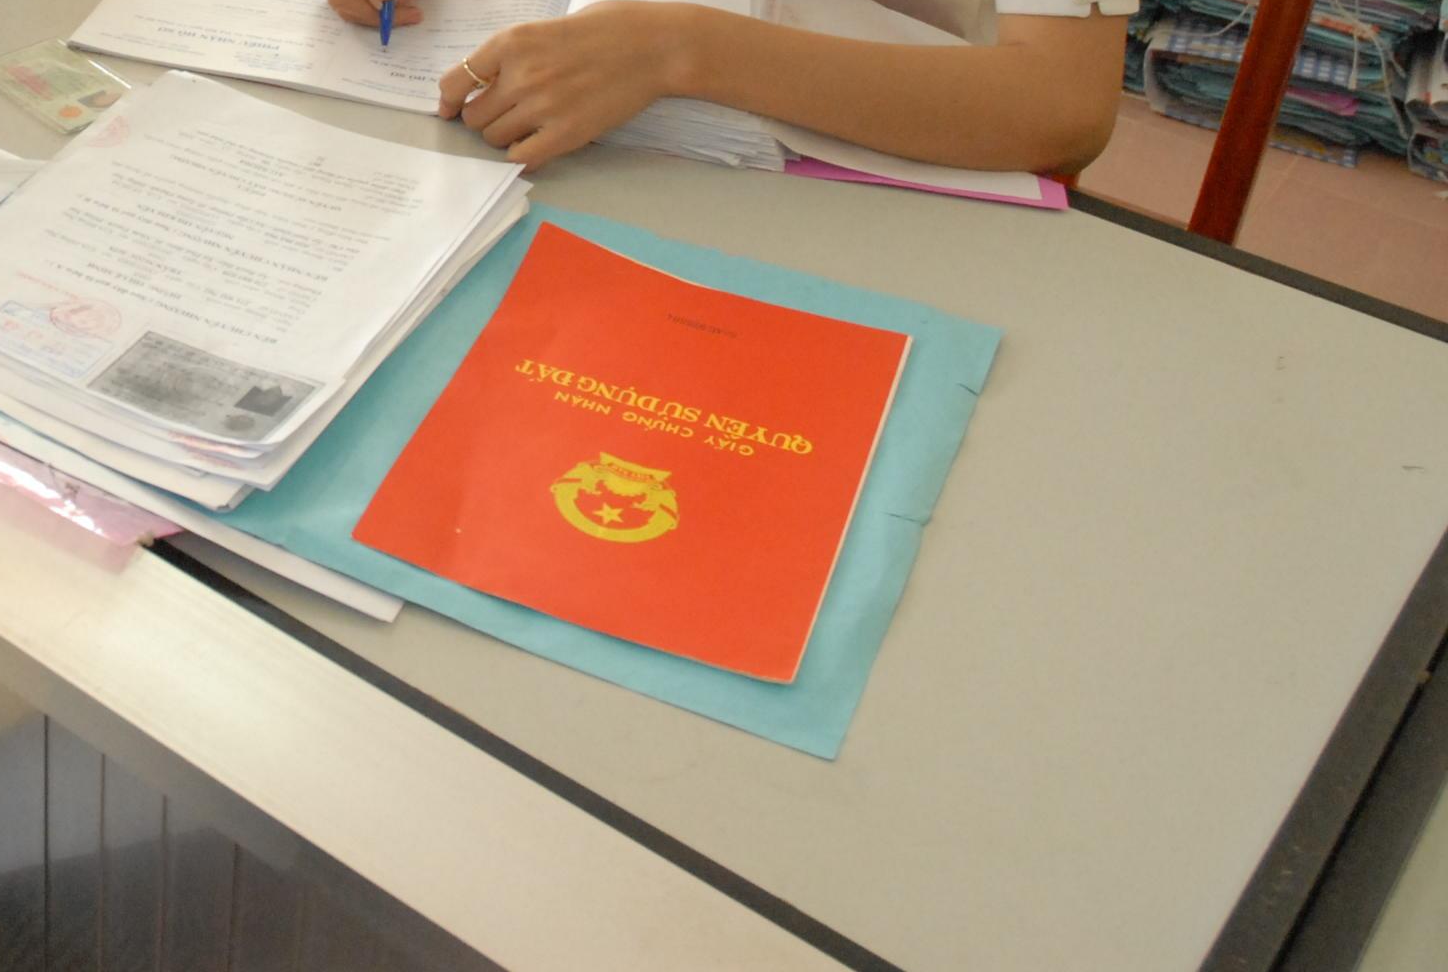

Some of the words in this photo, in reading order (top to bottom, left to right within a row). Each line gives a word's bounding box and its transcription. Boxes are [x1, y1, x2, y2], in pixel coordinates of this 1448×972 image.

[515, 359, 575, 387] ĐẤT
[577, 376, 661, 412] DỤNG
[657, 402, 702, 422] SỬ
[703, 413, 812, 454] QUYỀN
[704, 435, 754, 456] GIẤY
